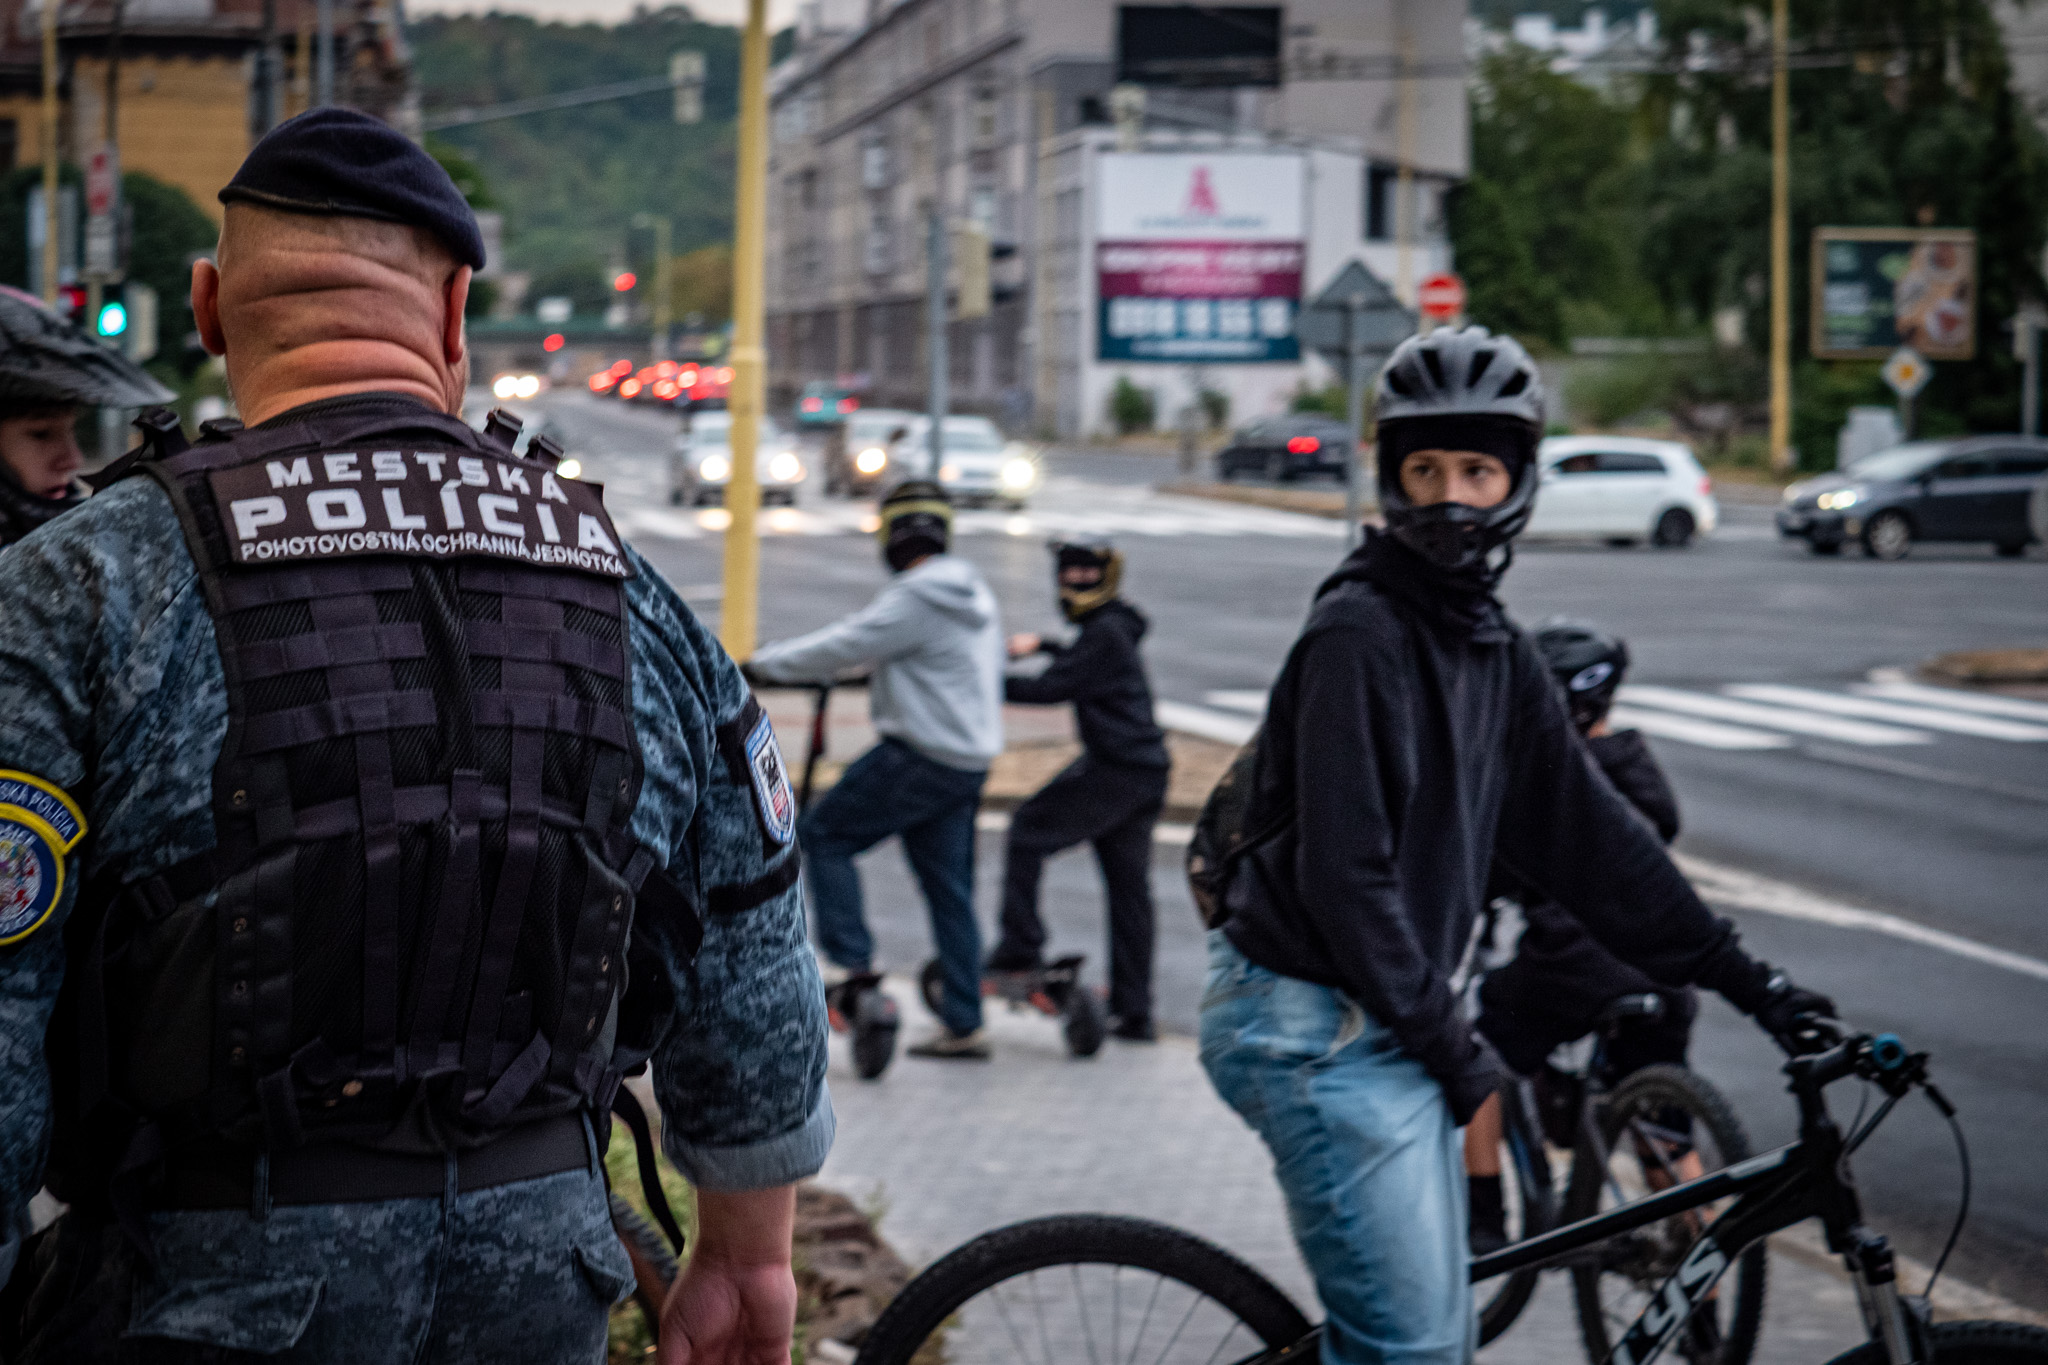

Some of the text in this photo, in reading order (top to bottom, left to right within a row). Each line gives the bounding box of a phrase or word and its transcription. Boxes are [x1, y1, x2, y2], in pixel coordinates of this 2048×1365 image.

[230, 478, 620, 556] POLÍCIA
[240, 528, 628, 576] POHOTOVOSTNÁ OCHRANNÁ JEDNOTKA
[0, 780, 29, 805] SKÁ
